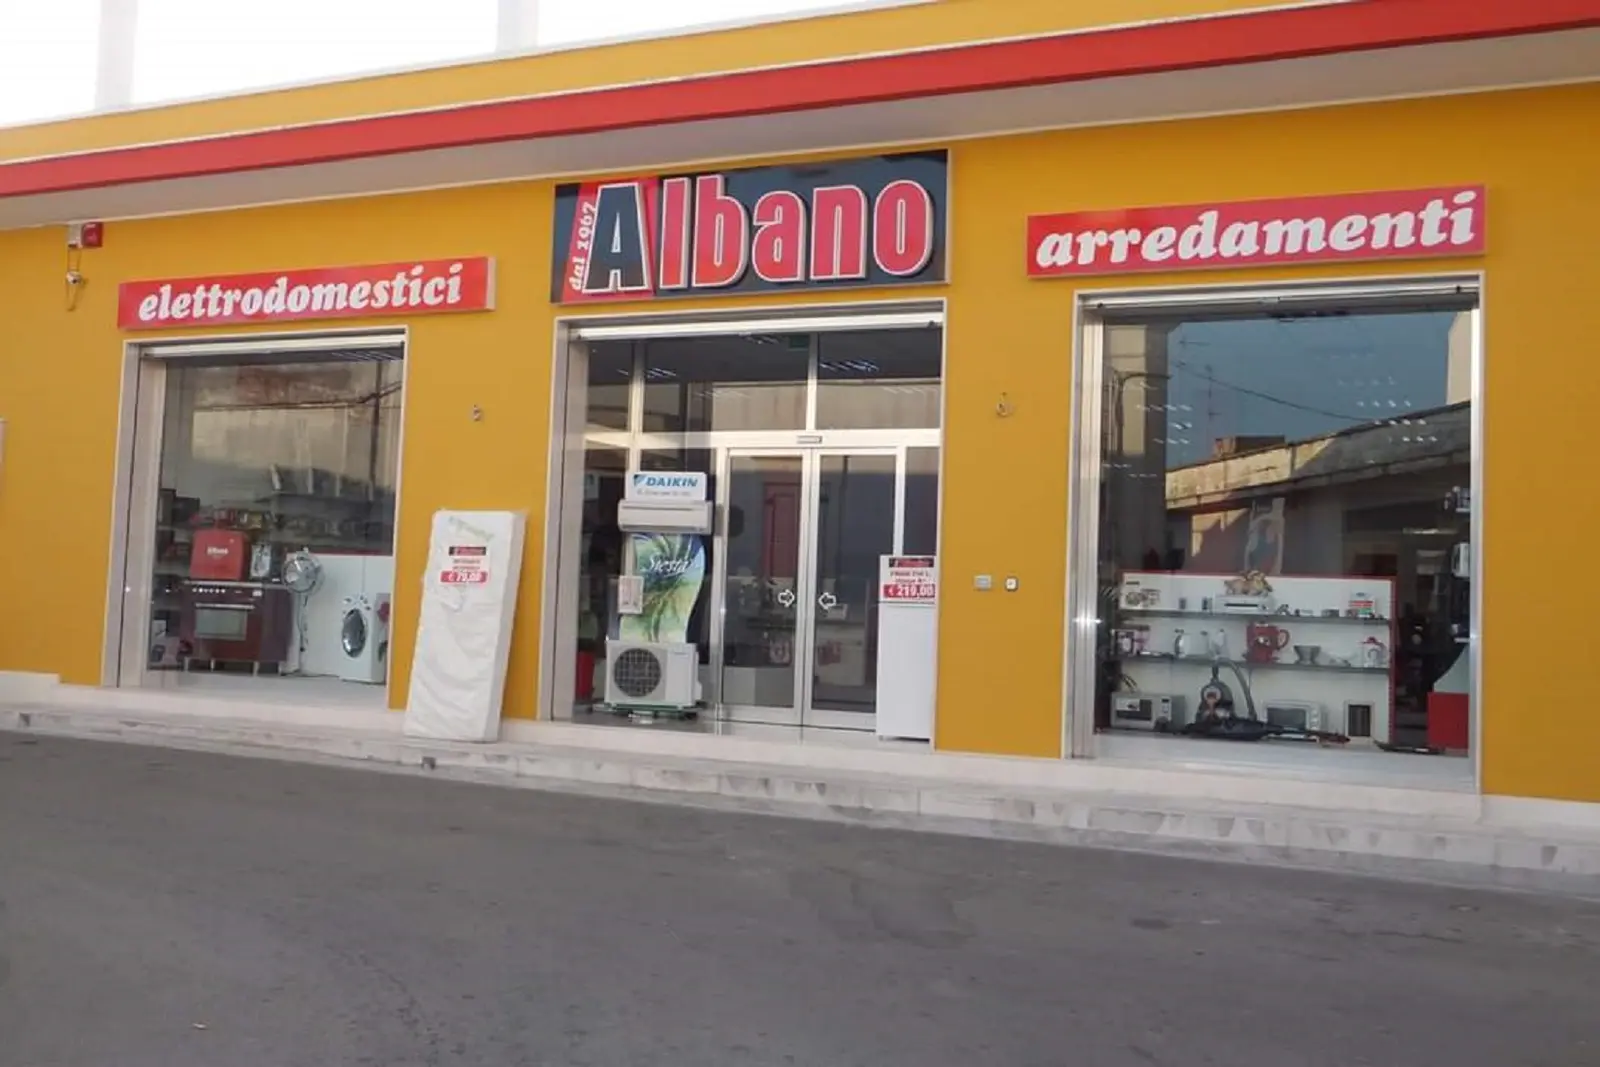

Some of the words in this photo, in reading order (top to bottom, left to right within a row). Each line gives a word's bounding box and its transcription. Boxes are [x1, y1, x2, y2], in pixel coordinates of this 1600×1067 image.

[575, 201, 597, 250] 1967
[581, 173, 935, 294] Albano
[1035, 190, 1477, 268] arredamenti
[138, 262, 464, 321] elettrodomestici
[568, 256, 586, 291] dal
[645, 476, 698, 487] DAIKIN
